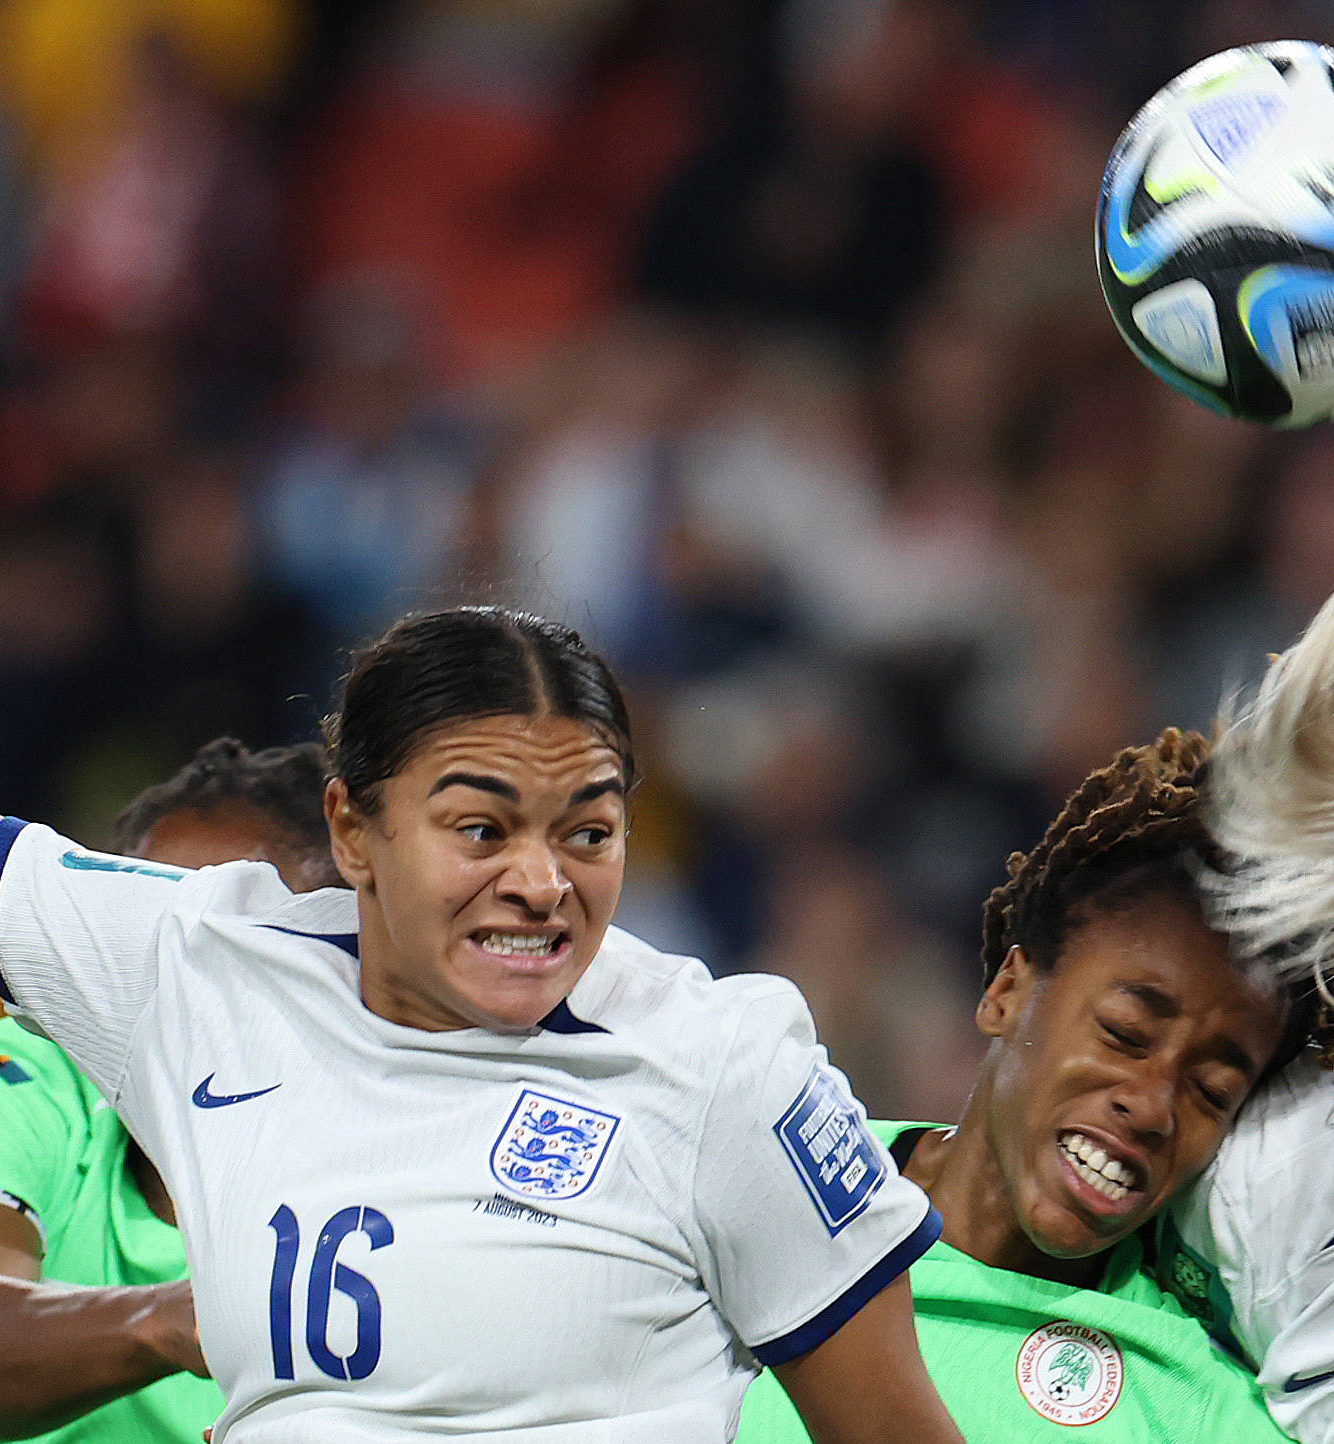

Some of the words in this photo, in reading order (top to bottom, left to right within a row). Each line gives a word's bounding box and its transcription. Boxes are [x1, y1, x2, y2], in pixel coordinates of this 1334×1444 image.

[483, 1201, 526, 1221] AUGUST
[527, 1209, 558, 1228] 2023
[267, 1203, 396, 1382] 16
[1022, 1336, 1047, 1383] NIGERIA
[1046, 1325, 1109, 1354] FOOTBALL
